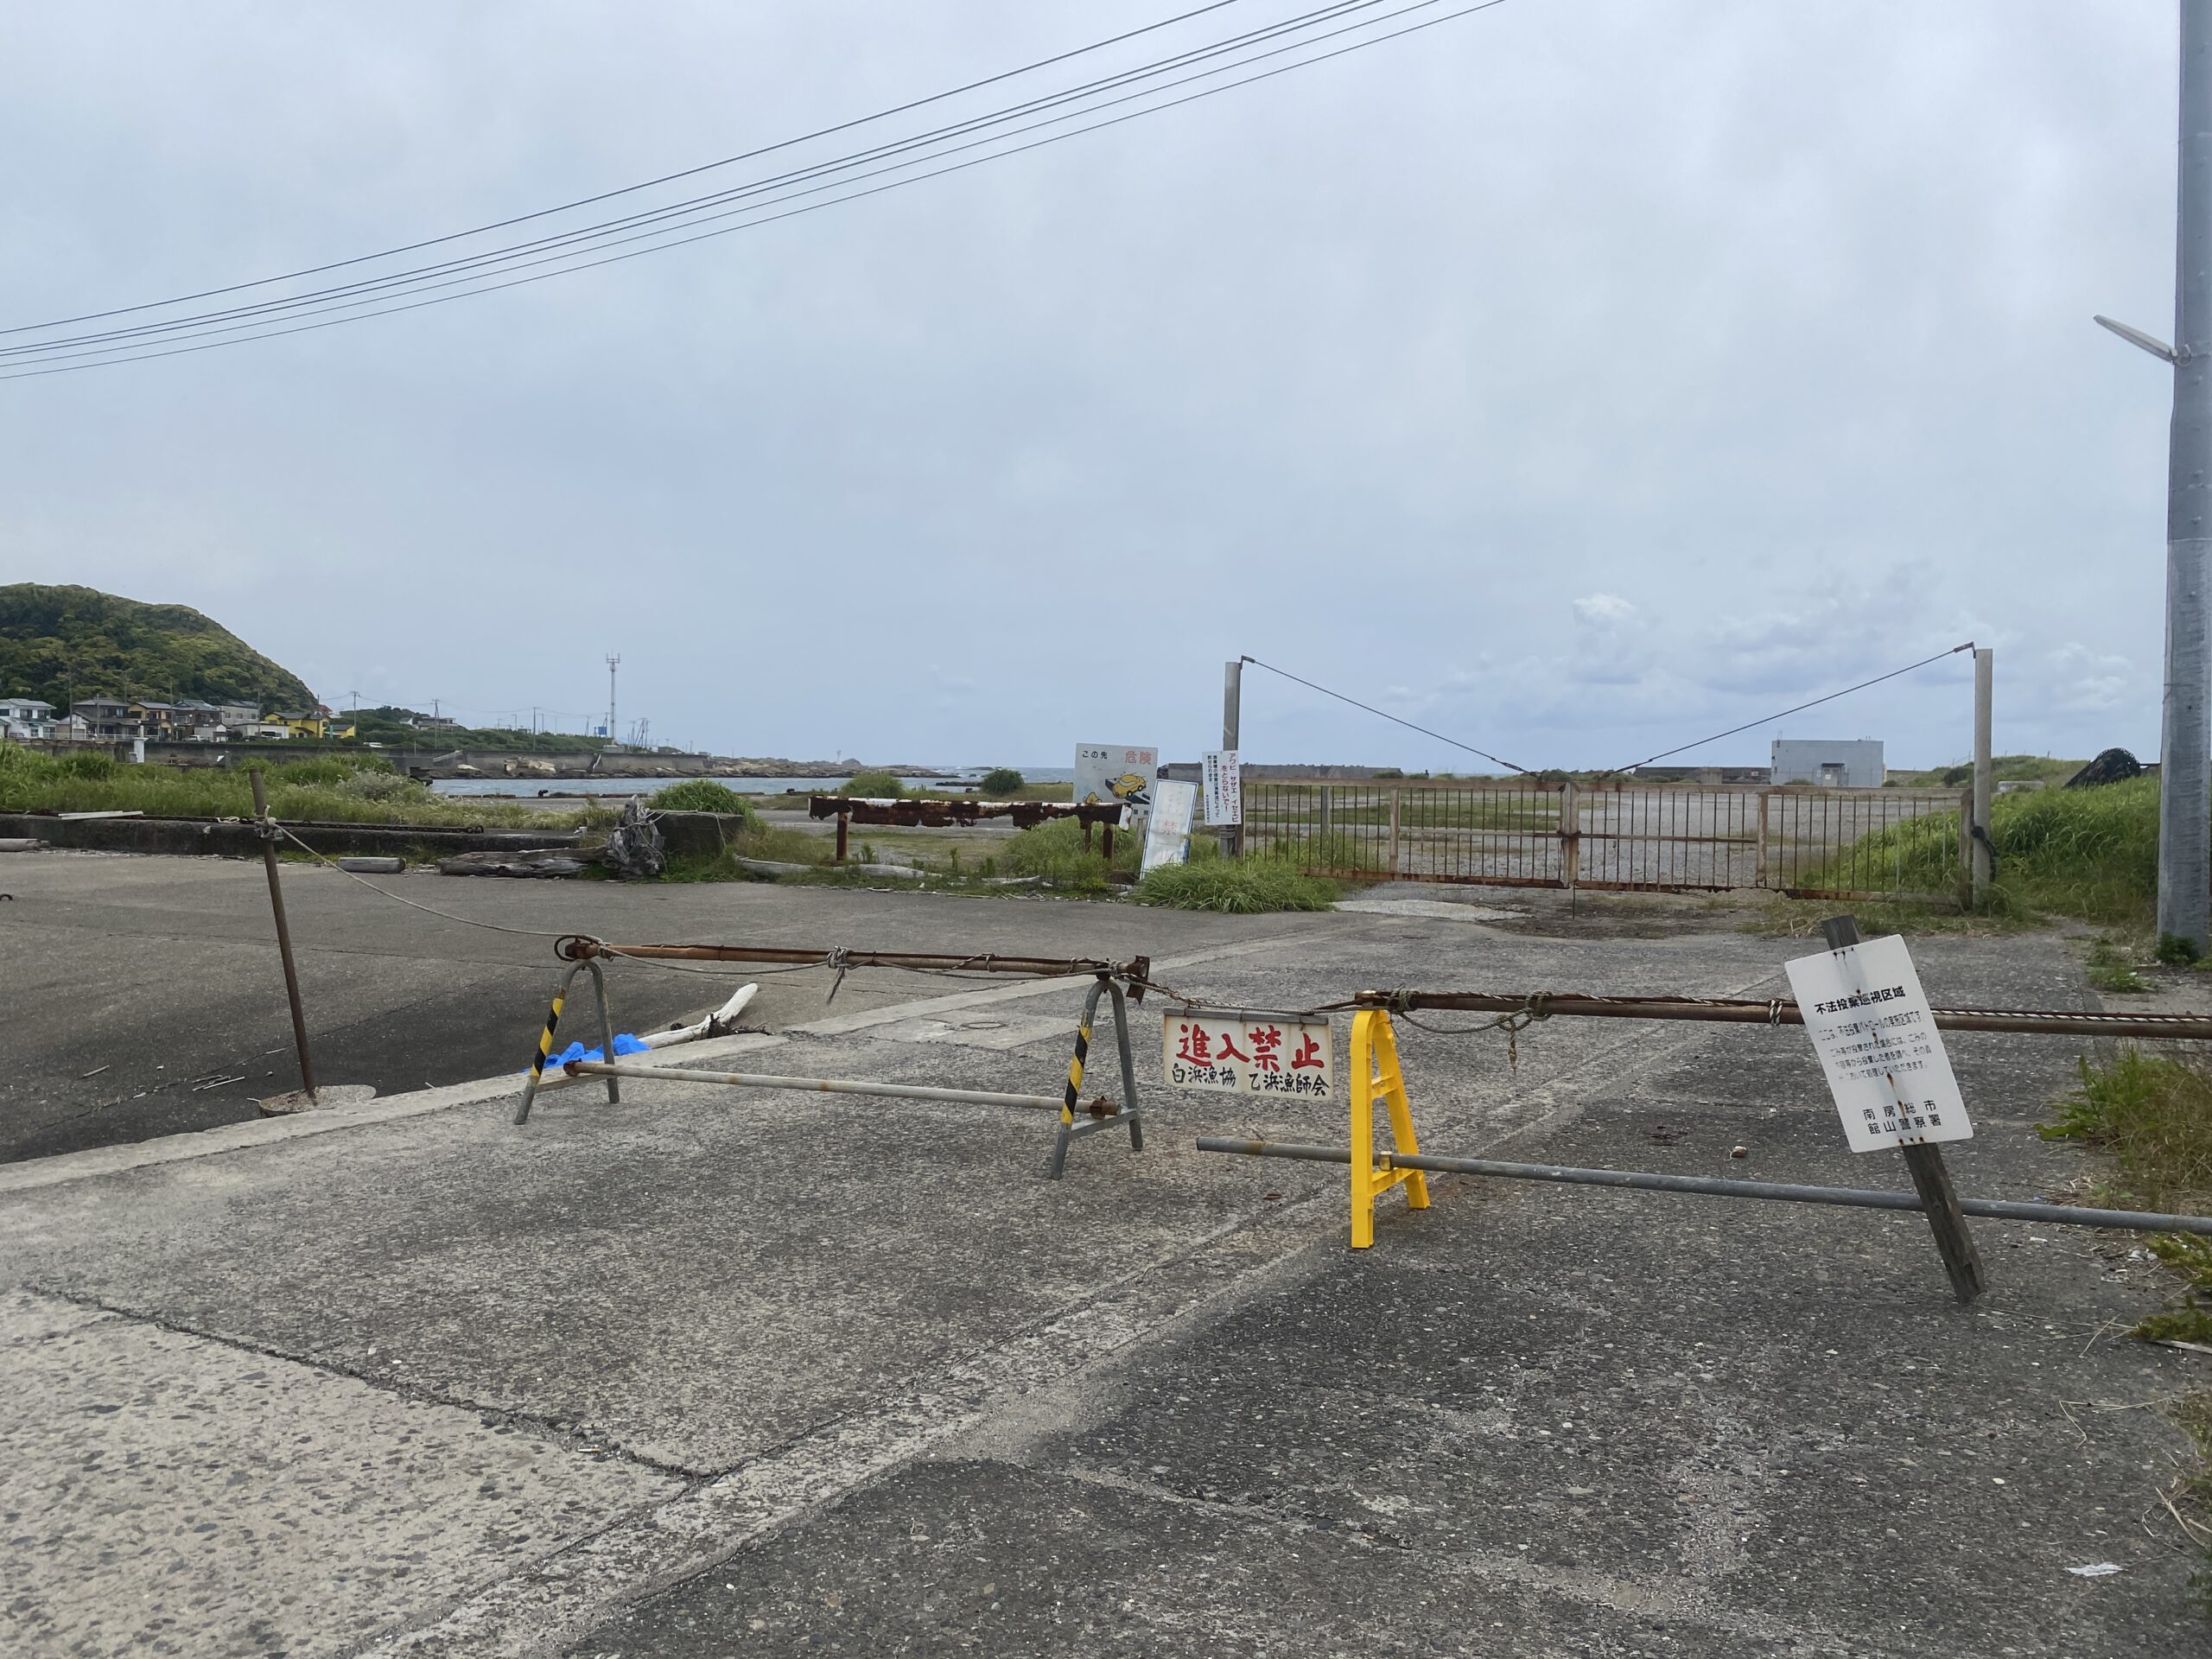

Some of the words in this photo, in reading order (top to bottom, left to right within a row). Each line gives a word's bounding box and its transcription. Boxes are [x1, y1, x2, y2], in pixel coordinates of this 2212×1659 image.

[1082, 750, 1108, 760] この先
[1125, 750, 1152, 765] 危険
[1815, 986, 1906, 1015] 不法投棄巡視区域
[1176, 1023, 1325, 1072] 進入禁止
[1172, 1063, 1236, 1087] 白浜漁協
[1249, 1071, 1330, 1096] 乙浜漁師会
[1863, 1099, 1937, 1121] 南房総市
[1868, 1113, 1942, 1135] 館山警察署
